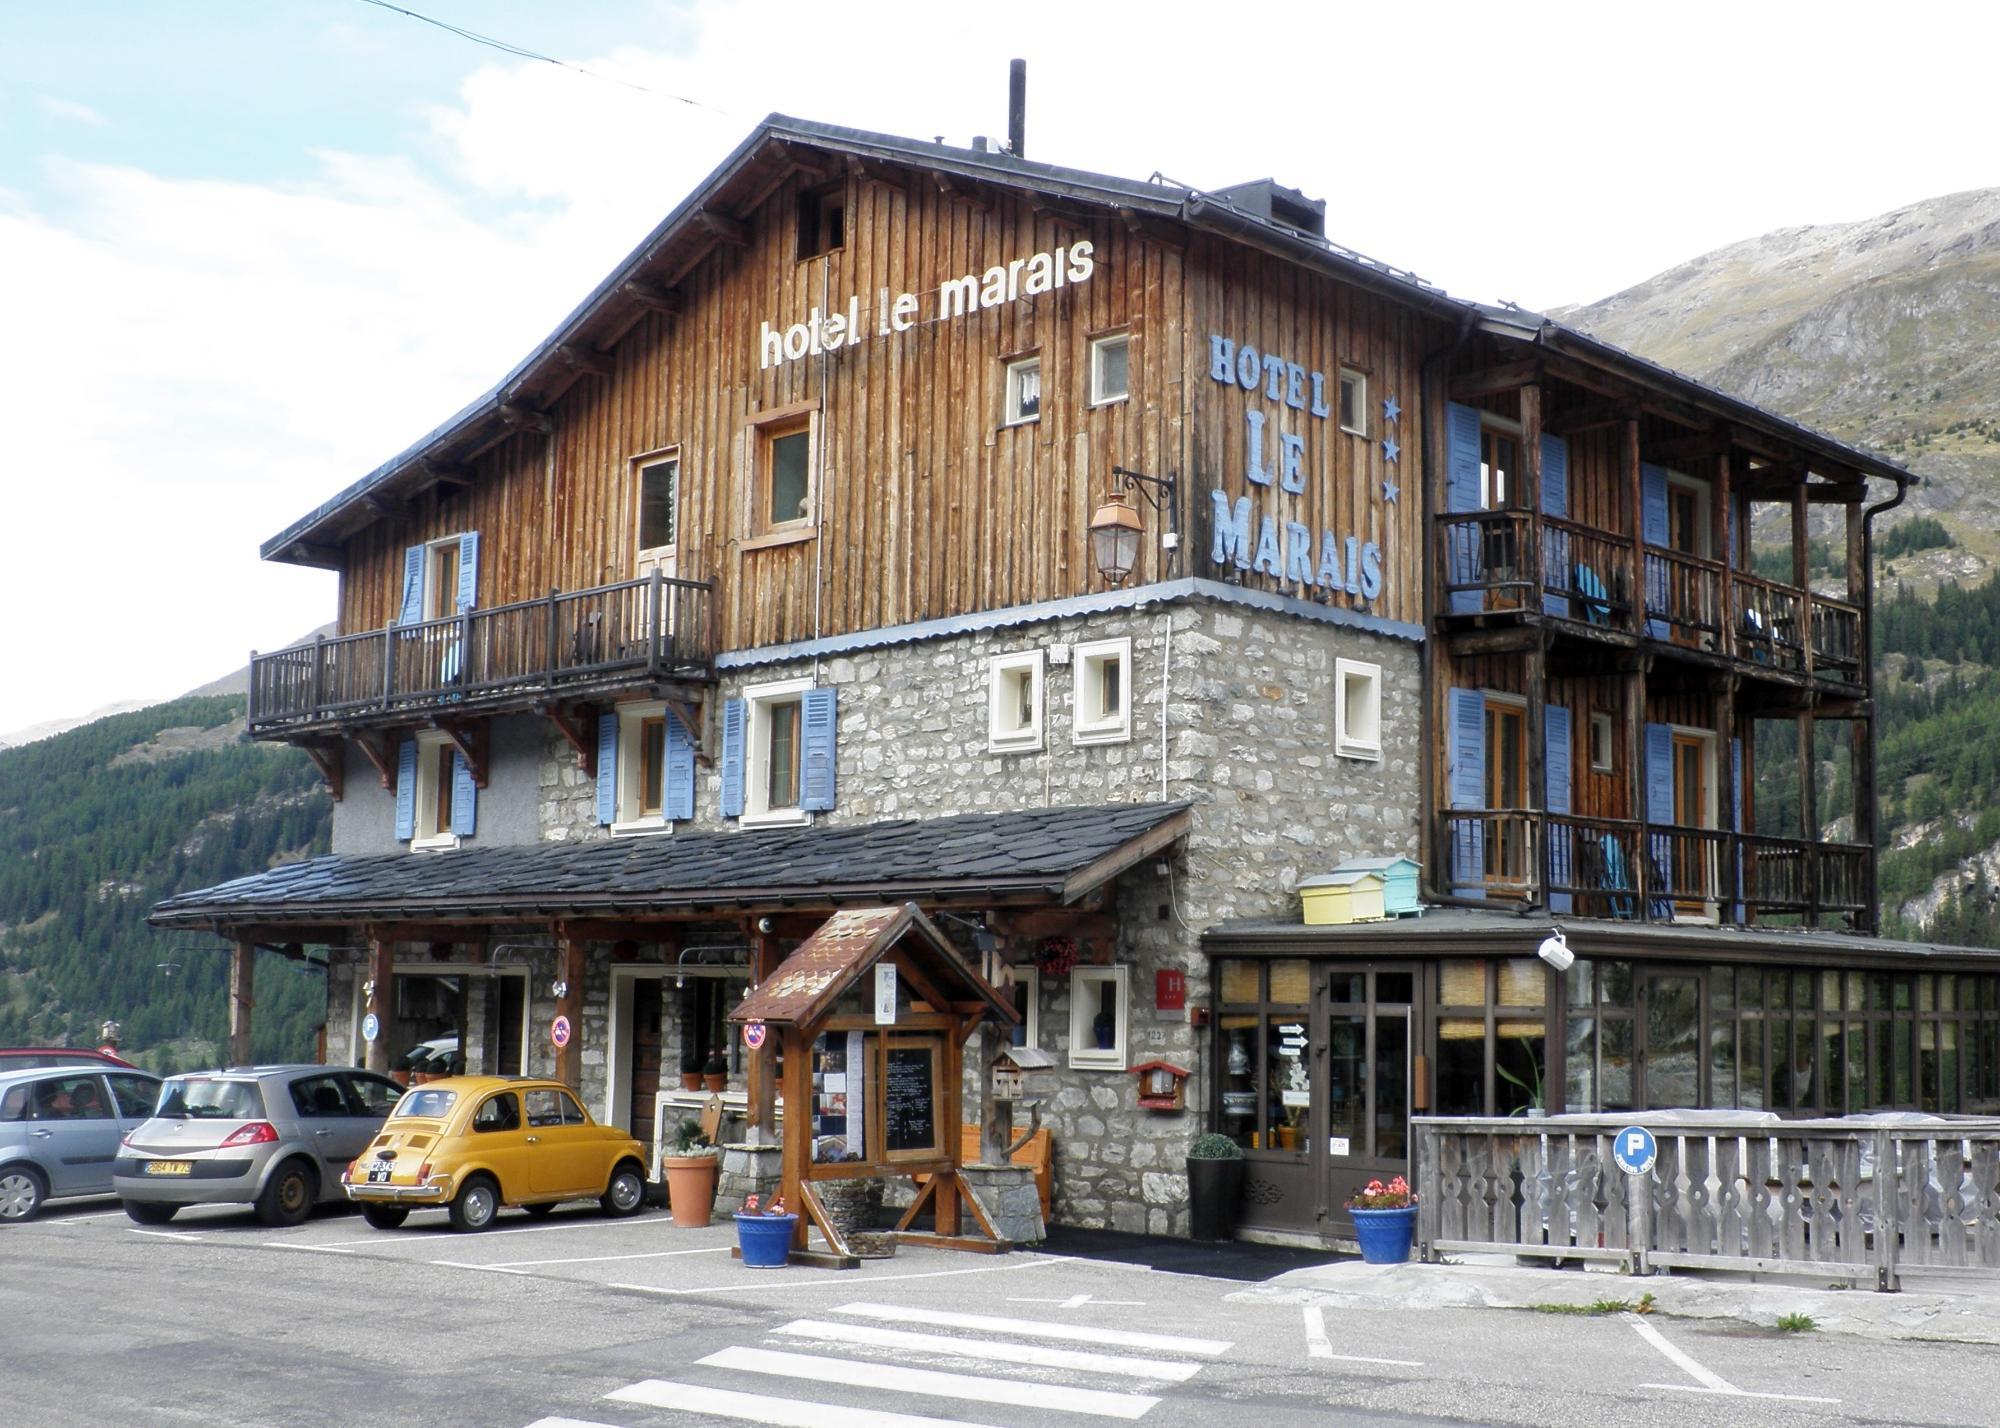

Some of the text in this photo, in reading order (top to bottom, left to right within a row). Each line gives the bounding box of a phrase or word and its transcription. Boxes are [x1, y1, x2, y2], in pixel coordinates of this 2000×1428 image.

[760, 240, 1094, 370] hotel le marais
[1209, 334, 1331, 419] HOTEL
[1246, 409, 1307, 495] LE
[1210, 489, 1382, 600] MARAIS
[1168, 976, 1182, 992] H
[1627, 1133, 1645, 1156] P
